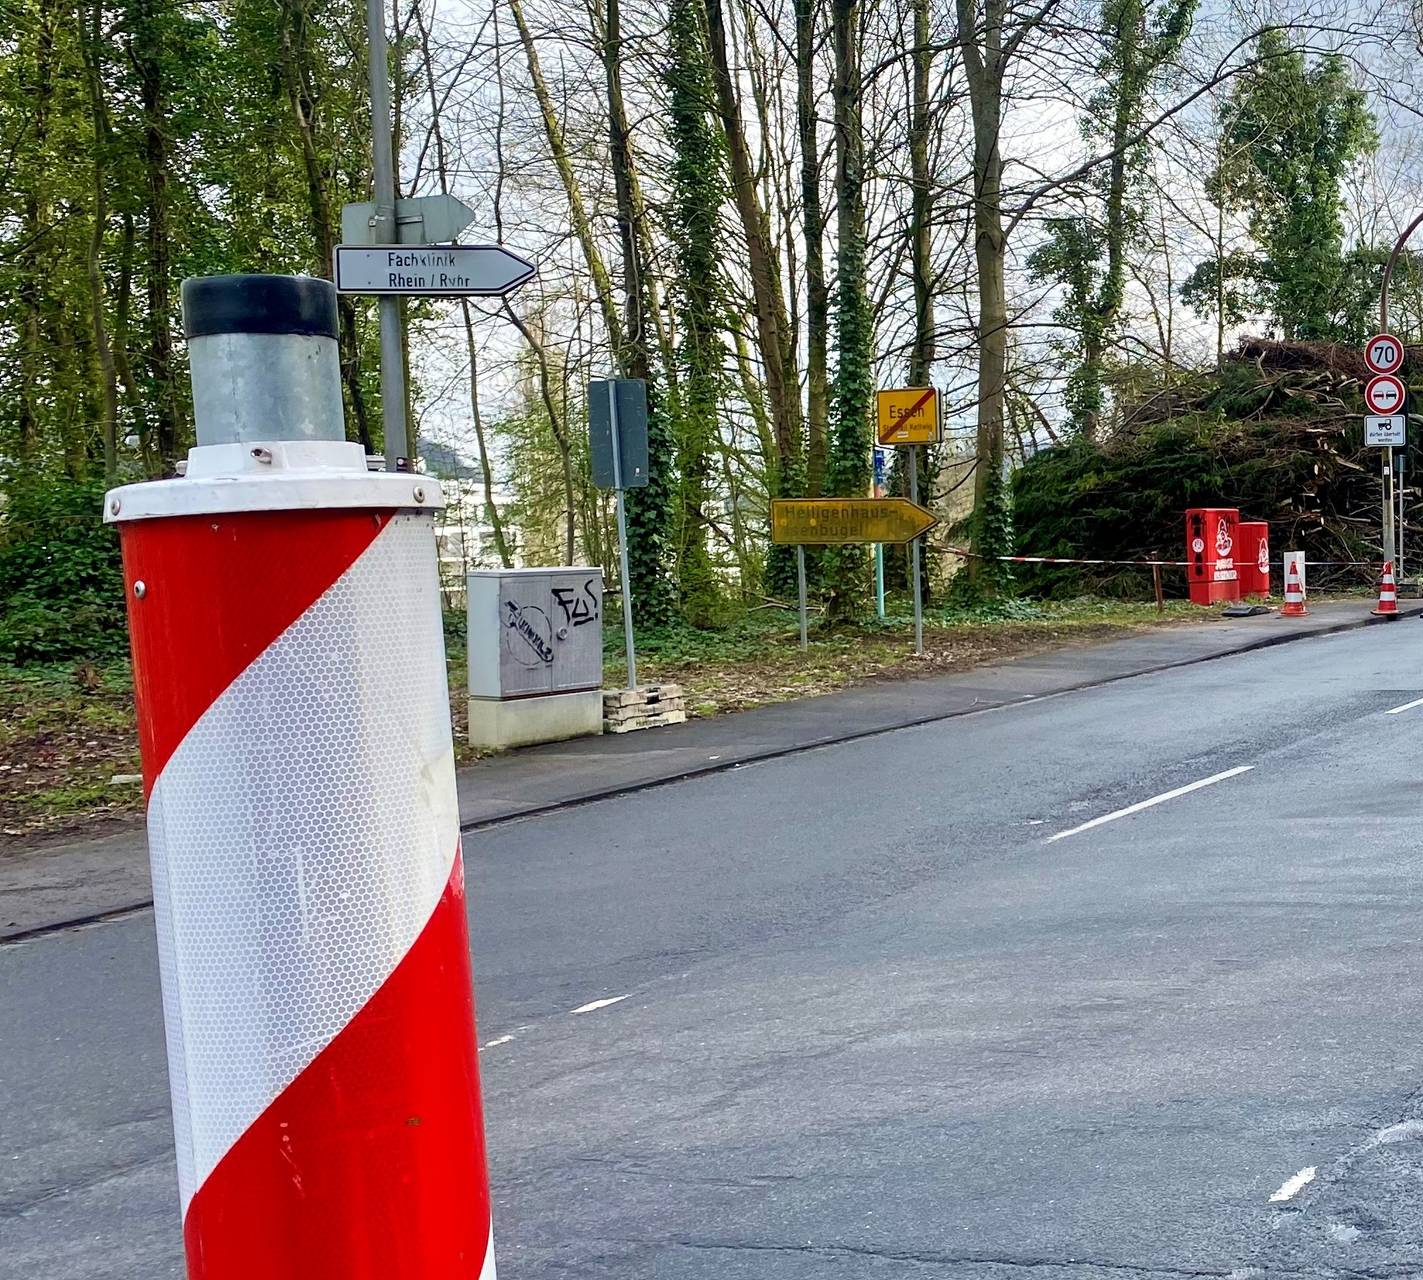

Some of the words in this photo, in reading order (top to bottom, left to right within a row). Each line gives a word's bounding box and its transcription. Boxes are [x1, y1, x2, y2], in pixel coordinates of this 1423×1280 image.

[388, 252, 456, 267] Fachklinik
[389, 272, 426, 288] Rhein
[1374, 346, 1395, 364] 70
[889, 404, 925, 419] Essen
